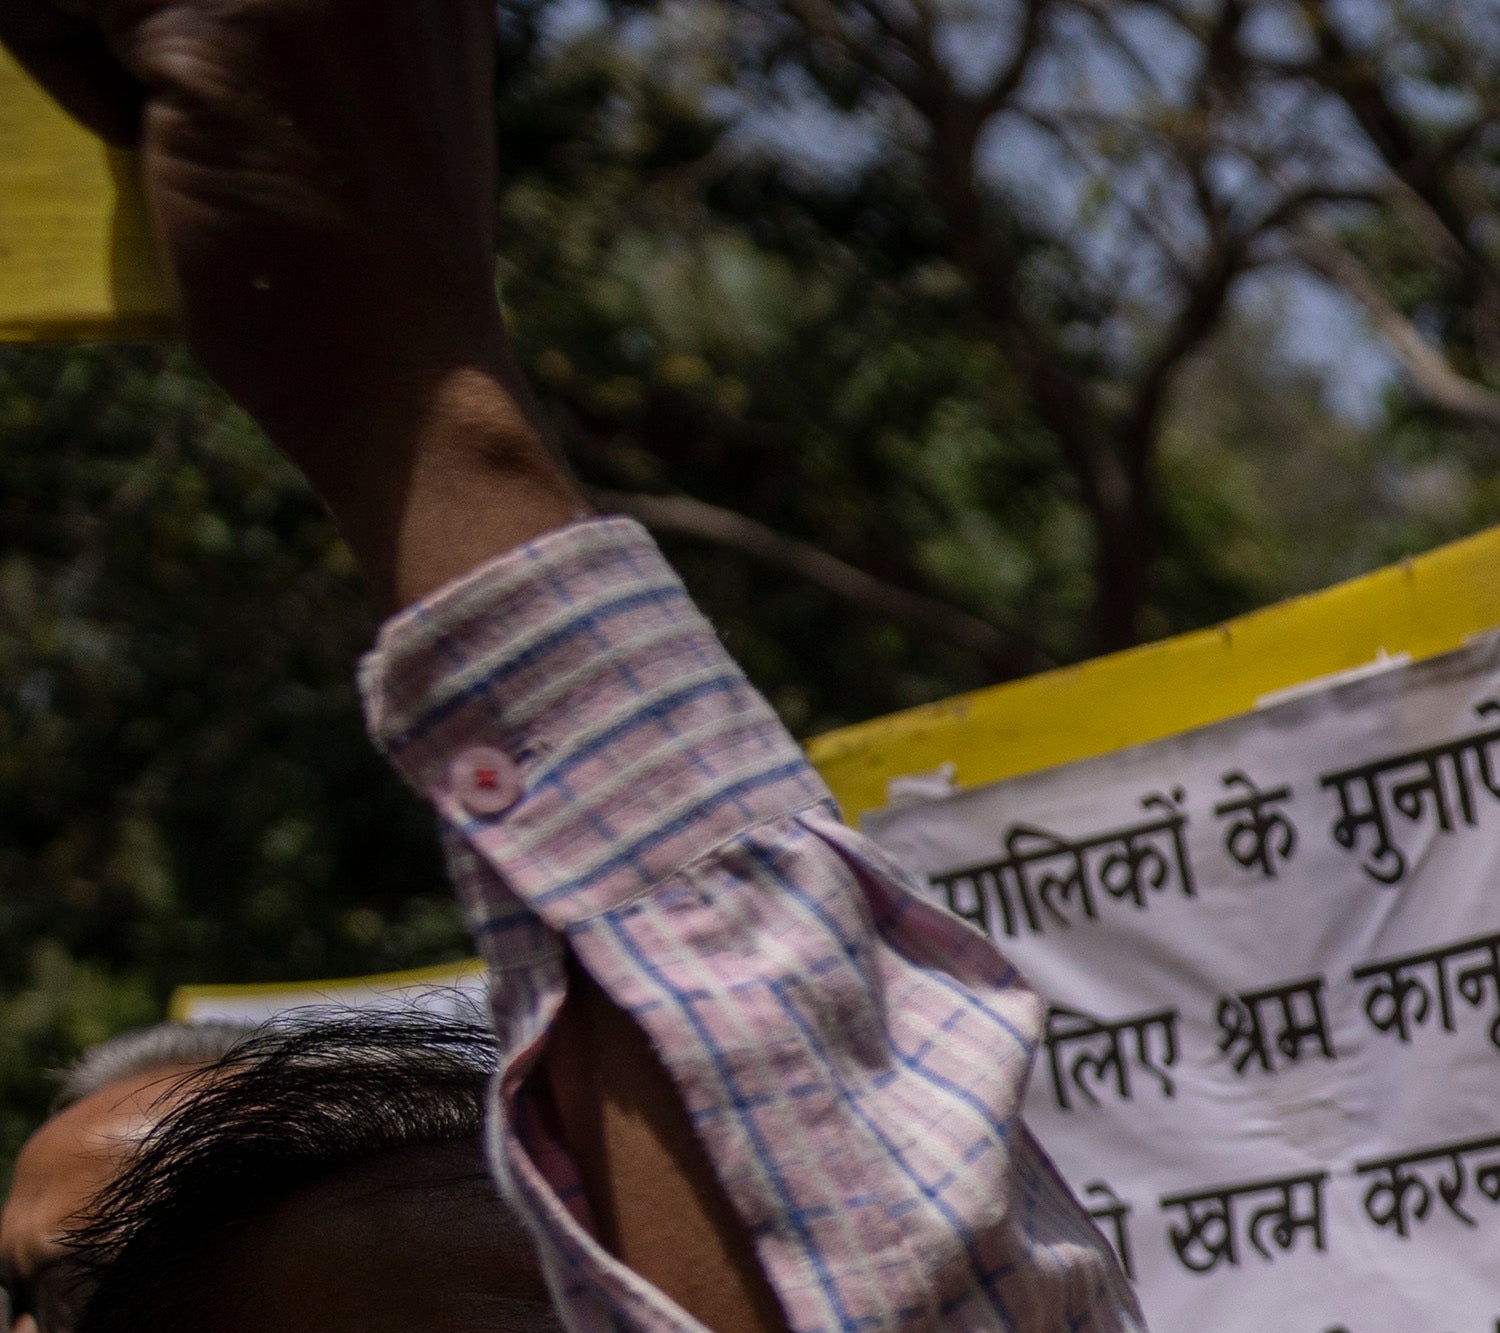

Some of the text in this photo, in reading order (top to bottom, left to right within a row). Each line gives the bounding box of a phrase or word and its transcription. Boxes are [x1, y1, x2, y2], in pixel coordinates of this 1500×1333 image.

[1214, 772, 1297, 878] के
[1043, 1004, 1179, 1110] लिए
[1216, 976, 1337, 1075] श्रम
[1161, 1171, 1332, 1275] खत्म
